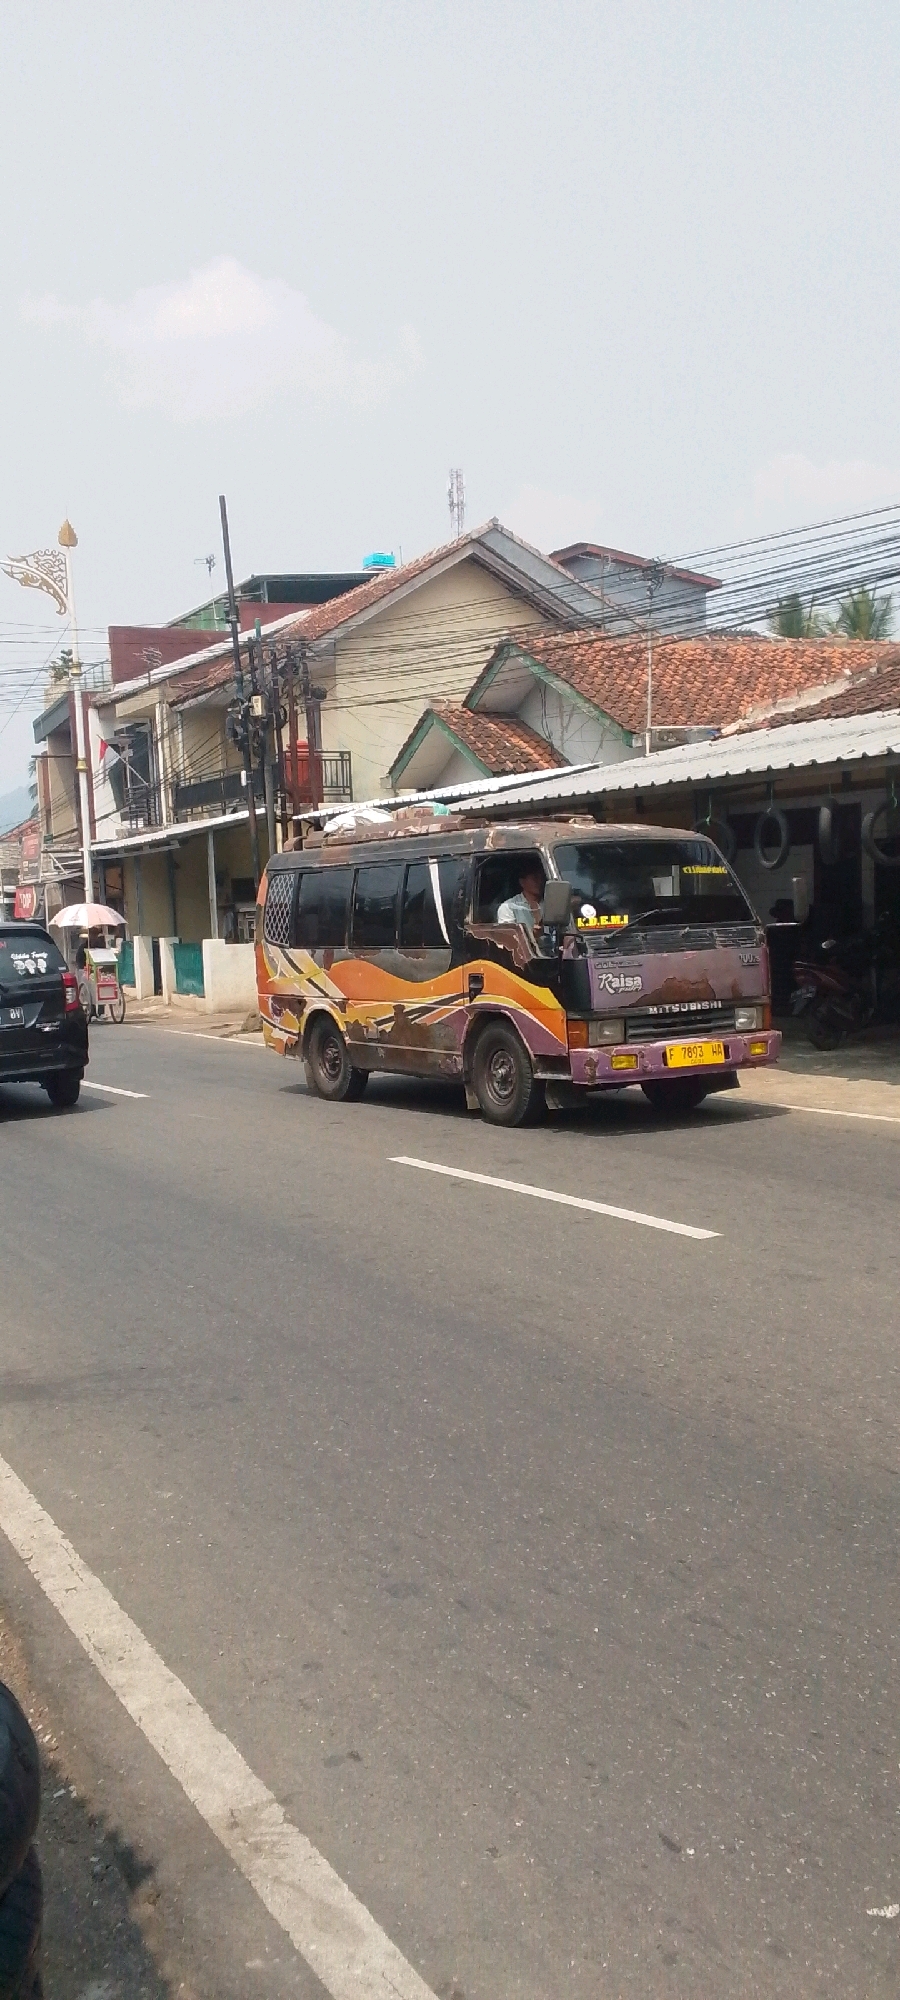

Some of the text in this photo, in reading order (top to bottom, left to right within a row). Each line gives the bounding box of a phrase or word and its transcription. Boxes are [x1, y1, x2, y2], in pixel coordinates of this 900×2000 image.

[598, 973, 642, 993] Raisa
[648, 1001, 723, 1014] MITSUBISHI
[668, 1048, 675, 1060] F
[681, 1045, 704, 1059] 7893
